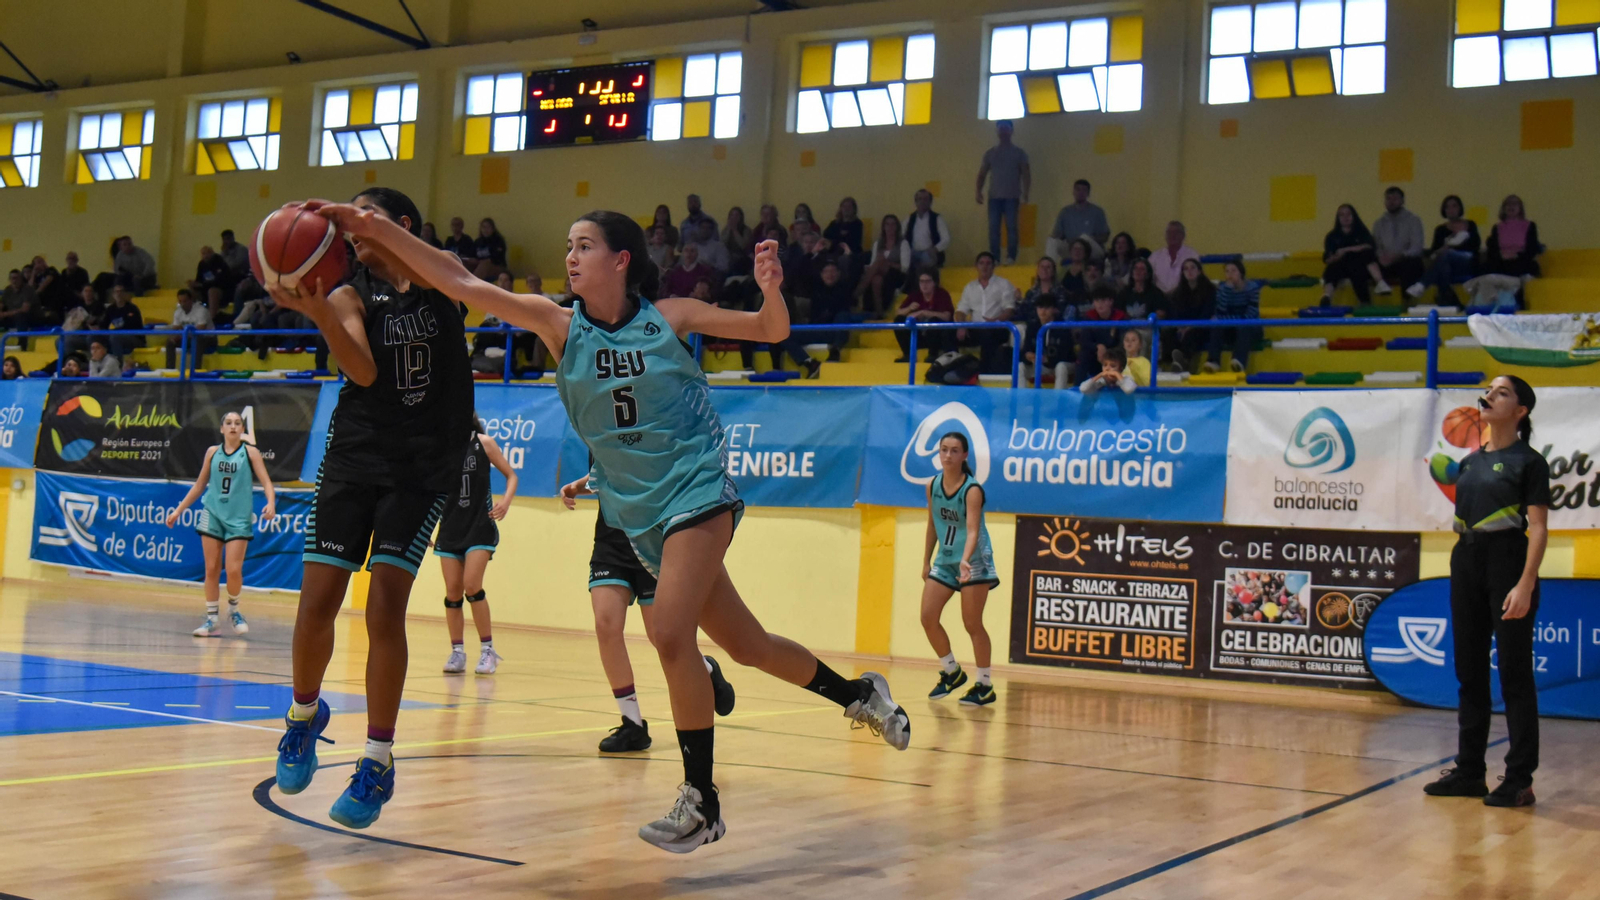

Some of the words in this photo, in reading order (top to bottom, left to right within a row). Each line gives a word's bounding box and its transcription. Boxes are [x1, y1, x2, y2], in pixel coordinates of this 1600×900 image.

[384, 305, 439, 345] MLG
[395, 342, 432, 389] 12
[611, 385, 639, 429] 5
[102, 437, 129, 448] Región
[131, 438, 162, 449] Europea
[1008, 419, 1187, 454] baloncesto
[101, 450, 140, 459] DEPORTE
[141, 451, 162, 460] 2021
[728, 451, 815, 477] ENIBLE
[221, 477, 231, 494] 9
[1274, 476, 1364, 496] baloncesto
[103, 531, 126, 557] de
[133, 533, 184, 563] Cádiz
[321, 541, 345, 552] vive
[943, 524, 957, 546] 11
[1218, 541, 1239, 559] C.
[1247, 542, 1273, 560] DE
[1281, 543, 1396, 564] GIBRALTAR
[1036, 576, 1062, 592] BAR
[1072, 578, 1117, 595] SNACK
[1127, 581, 1188, 600] TERRAZA
[1035, 597, 1188, 630] RESTAURANTE
[1033, 627, 1115, 655] BUFFET
[1121, 633, 1186, 662] LIBRE
[1220, 629, 1363, 658] CELEBRACION
[1219, 656, 1245, 665] BODAS
[1250, 658, 1300, 669] COMUNIONES
[1305, 661, 1331, 671] CENAS
[1333, 663, 1344, 672] DE
